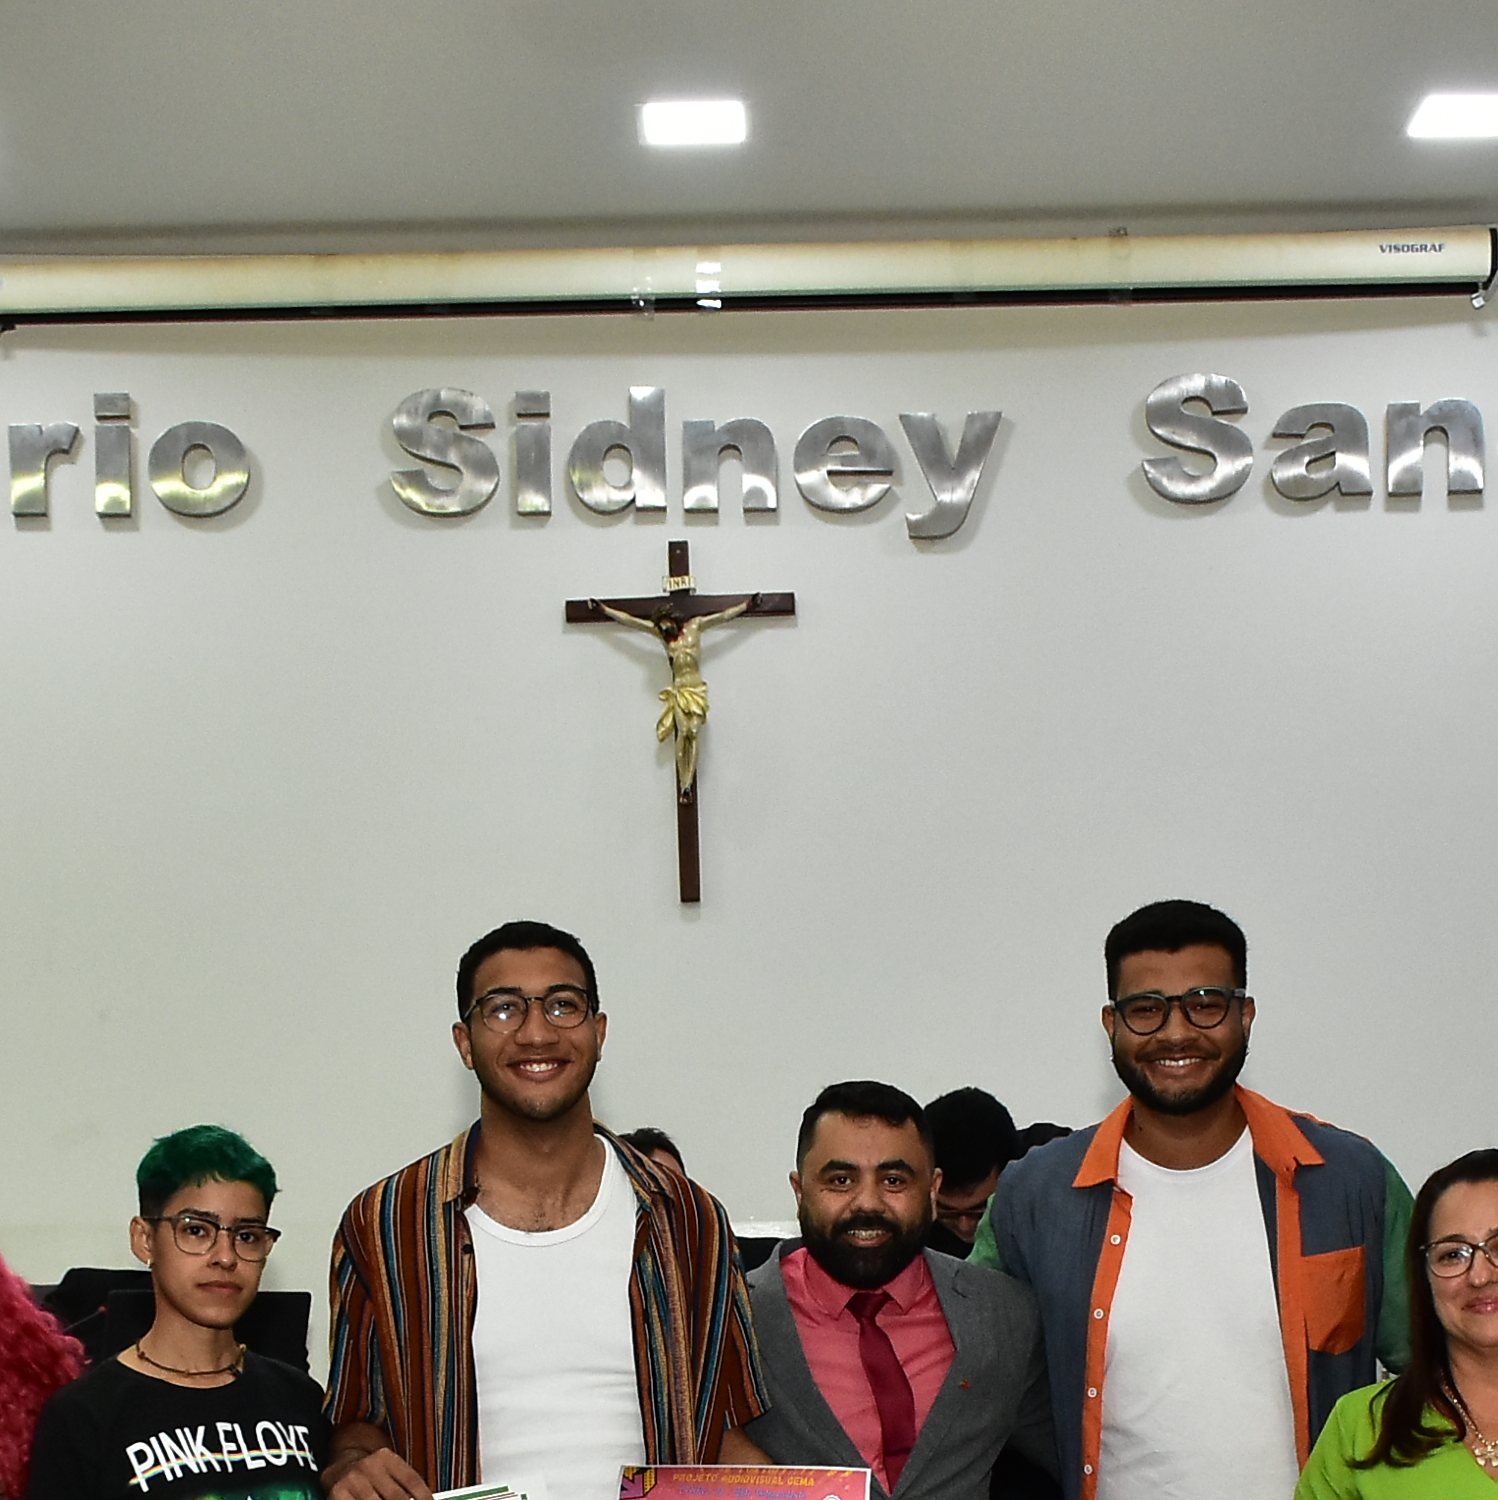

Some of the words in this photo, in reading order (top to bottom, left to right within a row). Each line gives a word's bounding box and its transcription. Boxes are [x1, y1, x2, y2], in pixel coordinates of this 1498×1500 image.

[1379, 243, 1445, 254] VISOGRAF
[390, 385, 1002, 540] Sidney
[125, 1425, 221, 1493] PINK
[673, 1473, 718, 1482] PROJETO
[722, 1475, 784, 1486] AUDIOVISUAL
